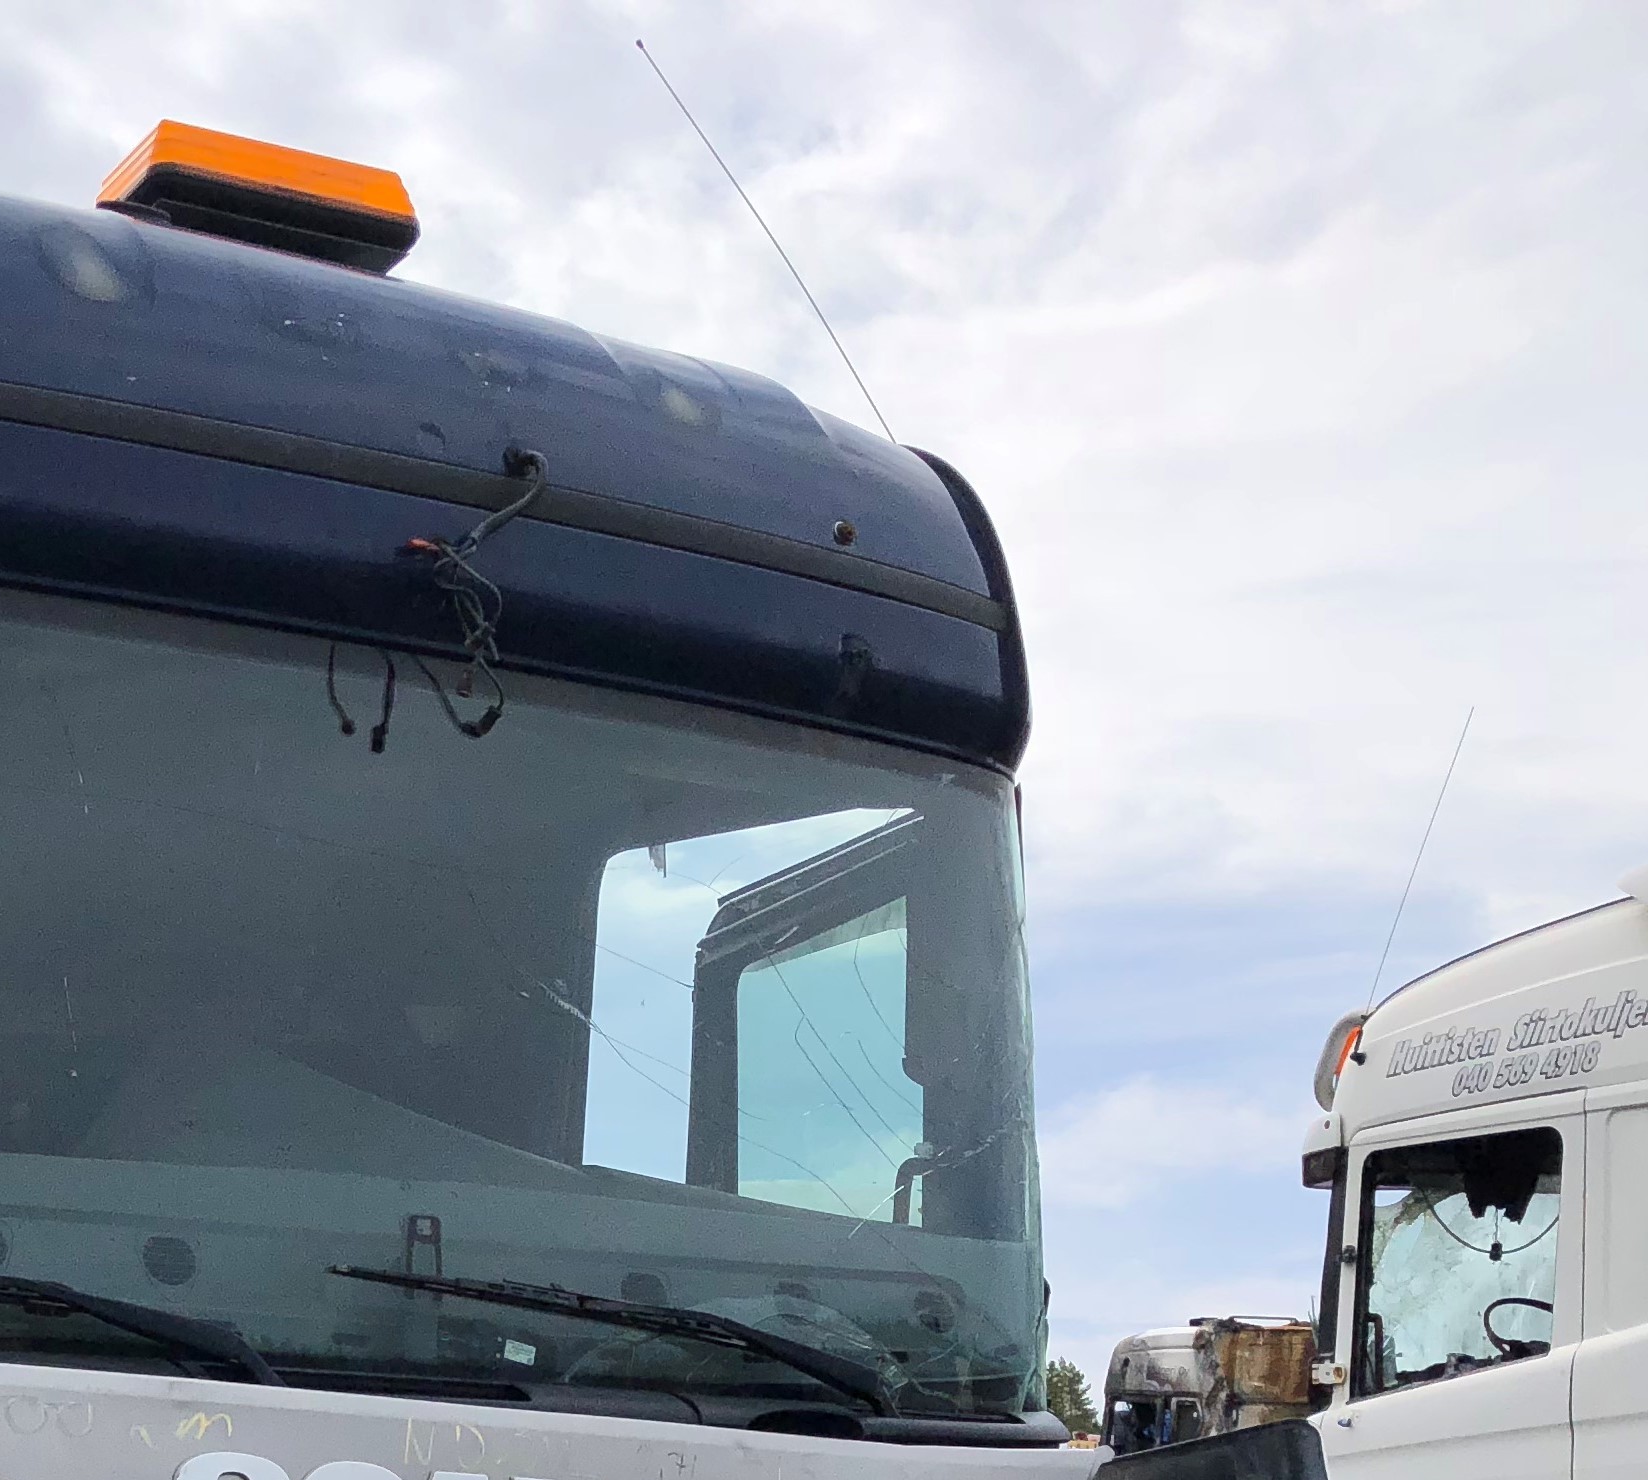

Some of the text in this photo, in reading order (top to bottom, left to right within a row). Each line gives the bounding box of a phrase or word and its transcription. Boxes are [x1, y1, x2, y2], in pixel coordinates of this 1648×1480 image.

[1386, 989, 1648, 1078] Huittisten Siirtokulje
[1452, 1061, 1494, 1097] 040
[1540, 1041, 1602, 1079] 4918
